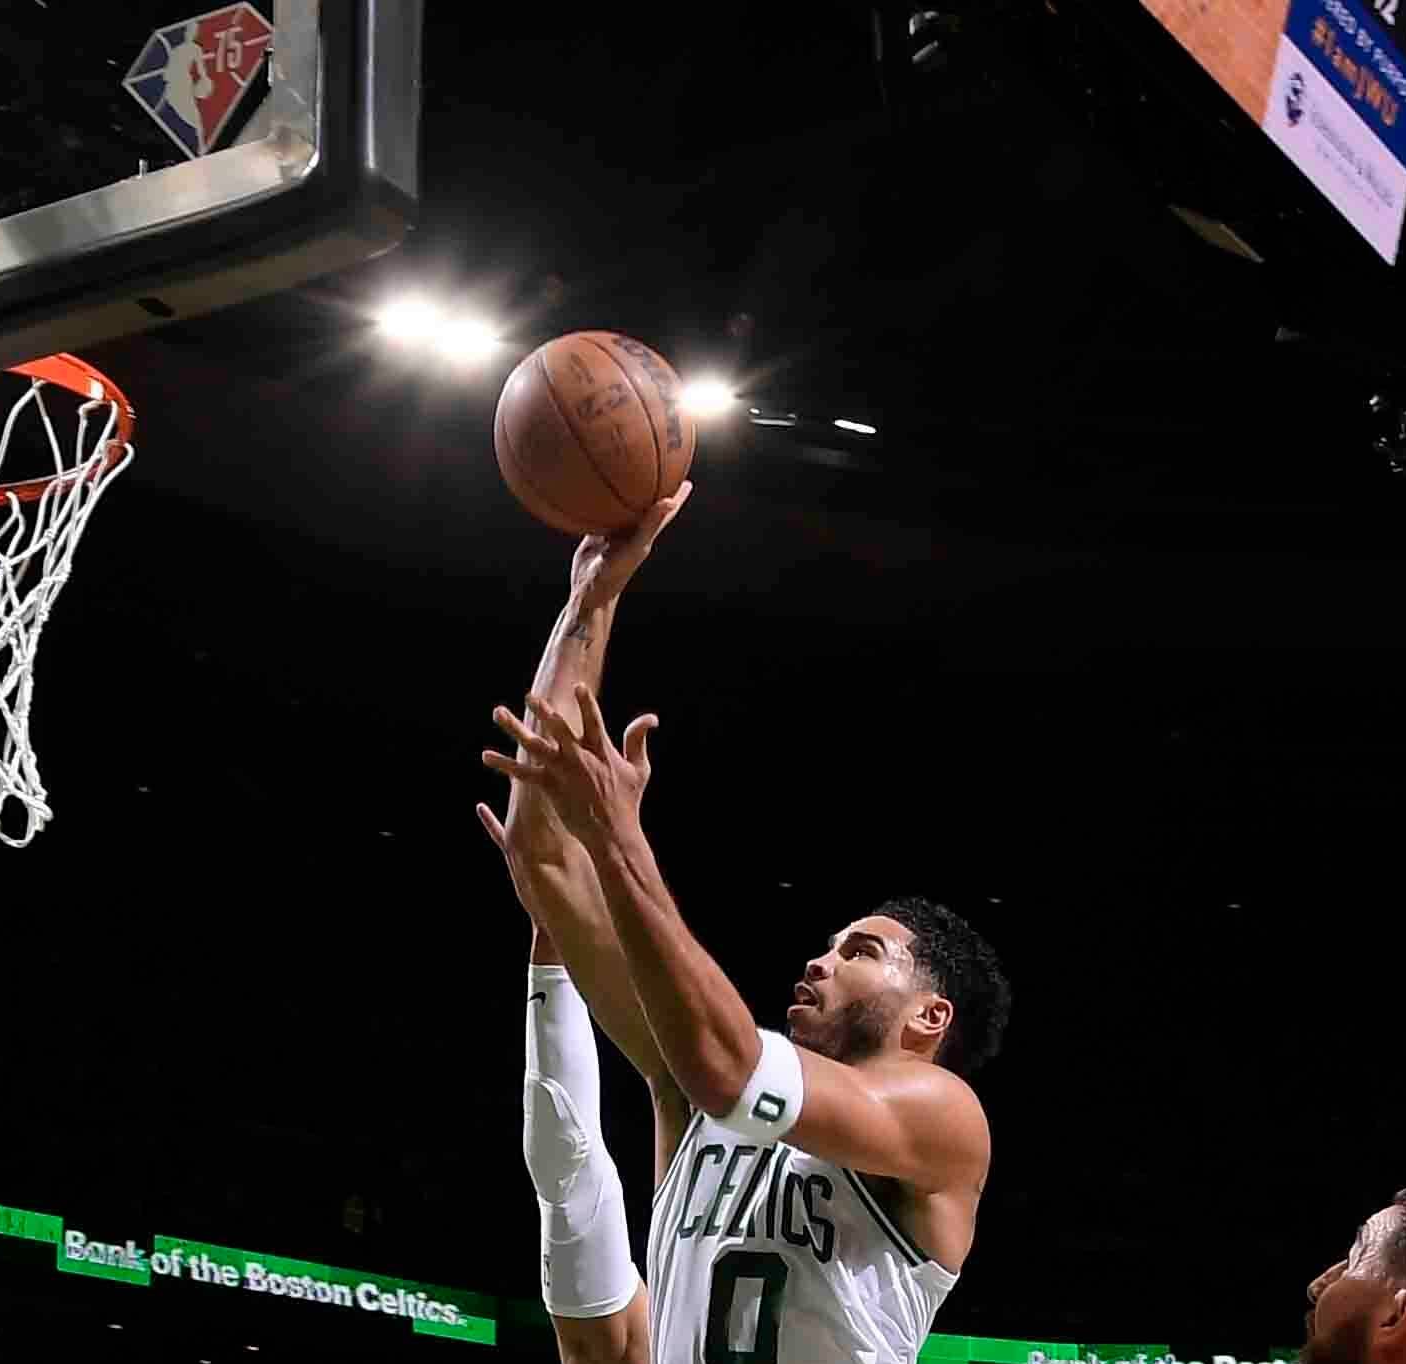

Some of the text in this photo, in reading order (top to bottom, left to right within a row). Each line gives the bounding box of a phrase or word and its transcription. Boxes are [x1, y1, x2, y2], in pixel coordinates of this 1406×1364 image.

[64, 1229, 468, 1327] Bank of the Boston Celtics.
